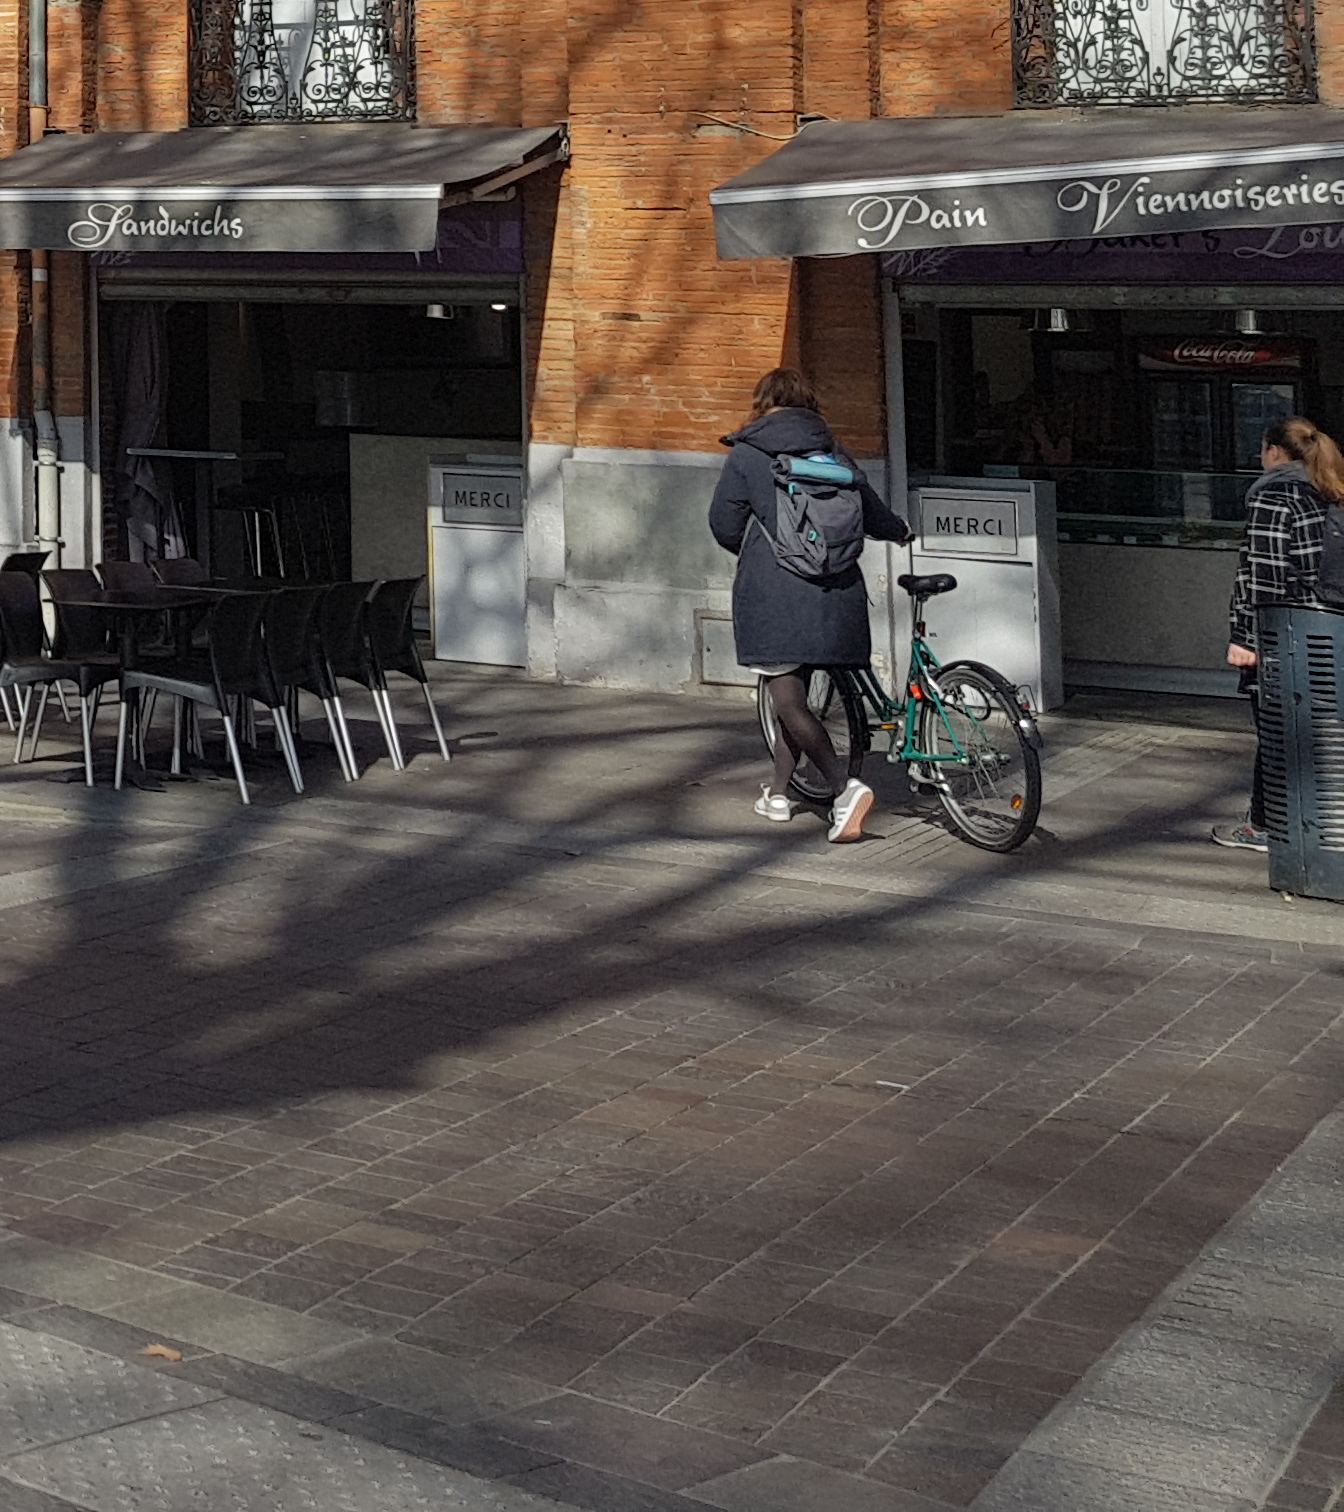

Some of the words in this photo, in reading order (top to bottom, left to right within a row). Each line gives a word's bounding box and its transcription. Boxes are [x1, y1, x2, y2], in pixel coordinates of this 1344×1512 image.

[67, 202, 244, 249] Sandwichs
[848, 194, 988, 249] Pain
[454, 490, 510, 508] MERCI
[935, 516, 1002, 536] MERCI
